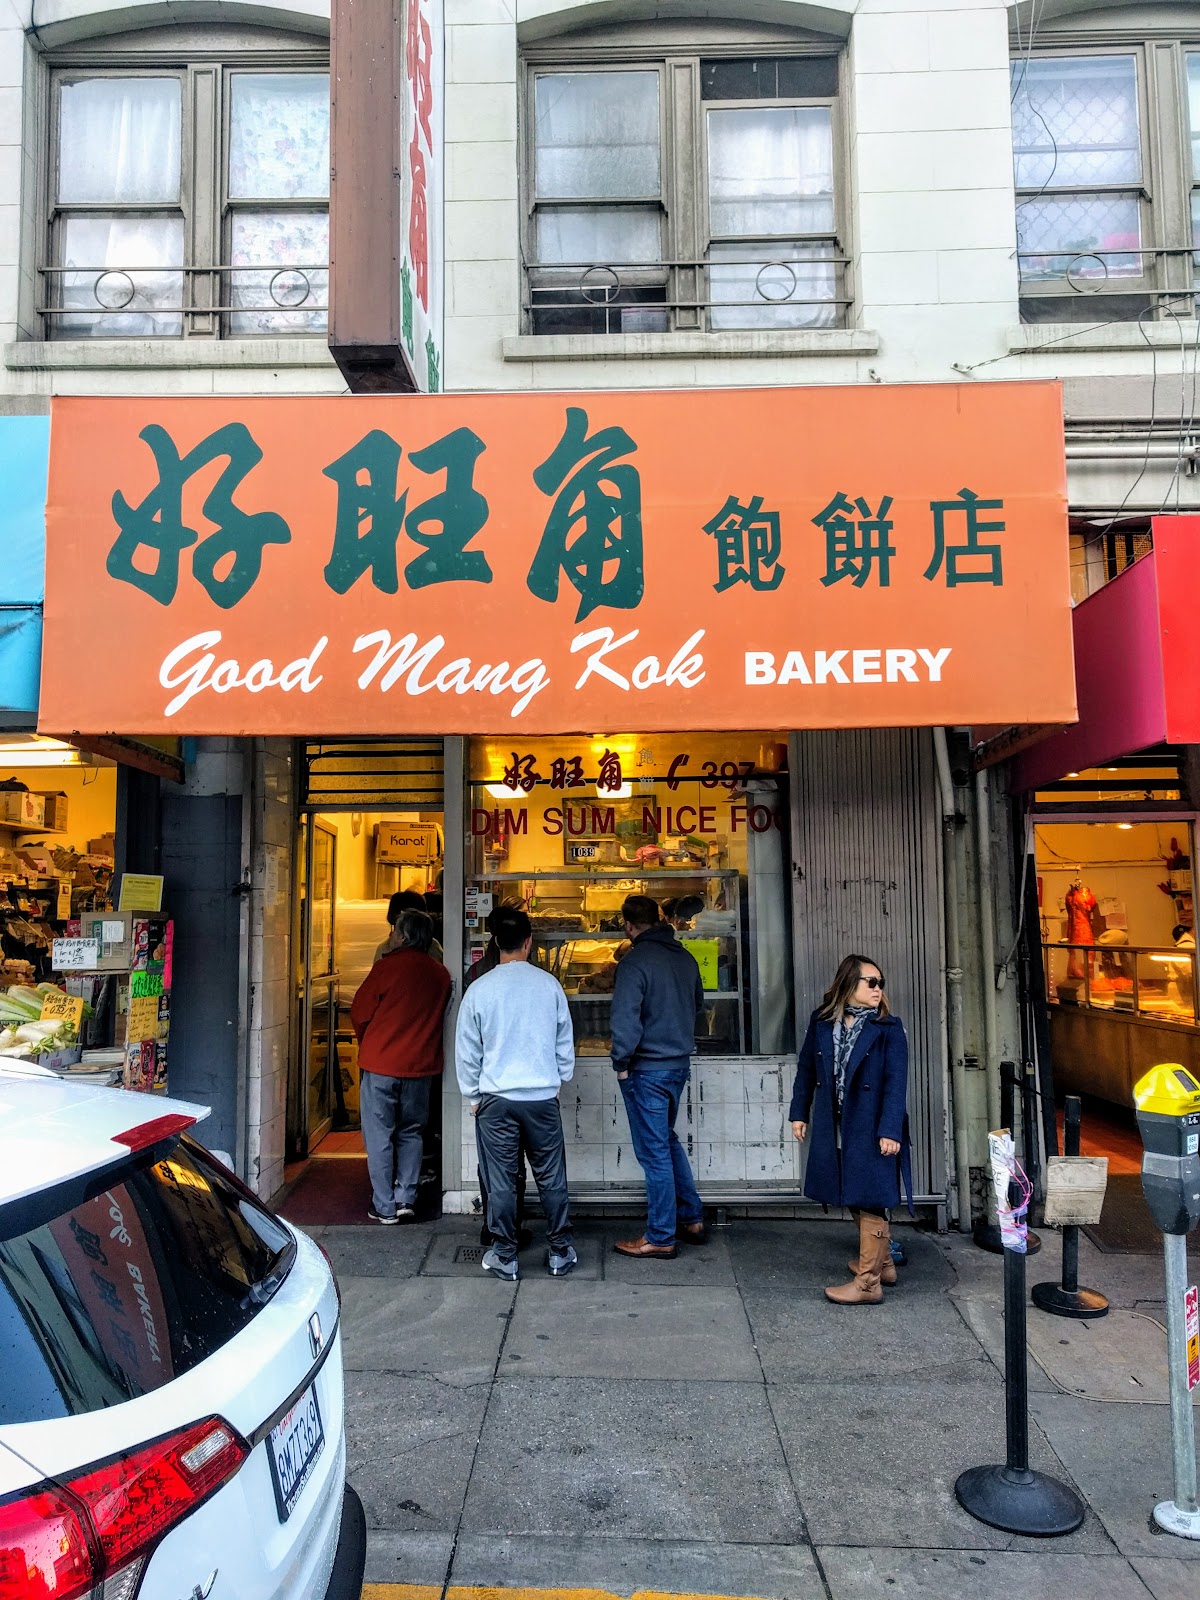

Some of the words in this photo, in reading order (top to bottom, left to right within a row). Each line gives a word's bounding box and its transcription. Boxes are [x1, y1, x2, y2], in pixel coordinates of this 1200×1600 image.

[106, 408, 644, 623] 好旺角
[702, 488, 1005, 593] 飽餅店
[159, 631, 328, 716] Good
[353, 630, 550, 717] Mang
[570, 627, 705, 690] Kok
[746, 648, 951, 684] BAKERY
[502, 748, 623, 792] 好旺角
[702, 761, 755, 789] 397
[472, 808, 528, 836] DIM
[543, 807, 615, 836] SUM
[643, 806, 717, 835] NICE
[390, 835, 425, 846] Karat
[572, 847, 595, 858] 1039
[278, 1400, 317, 1497] 8MZT369
